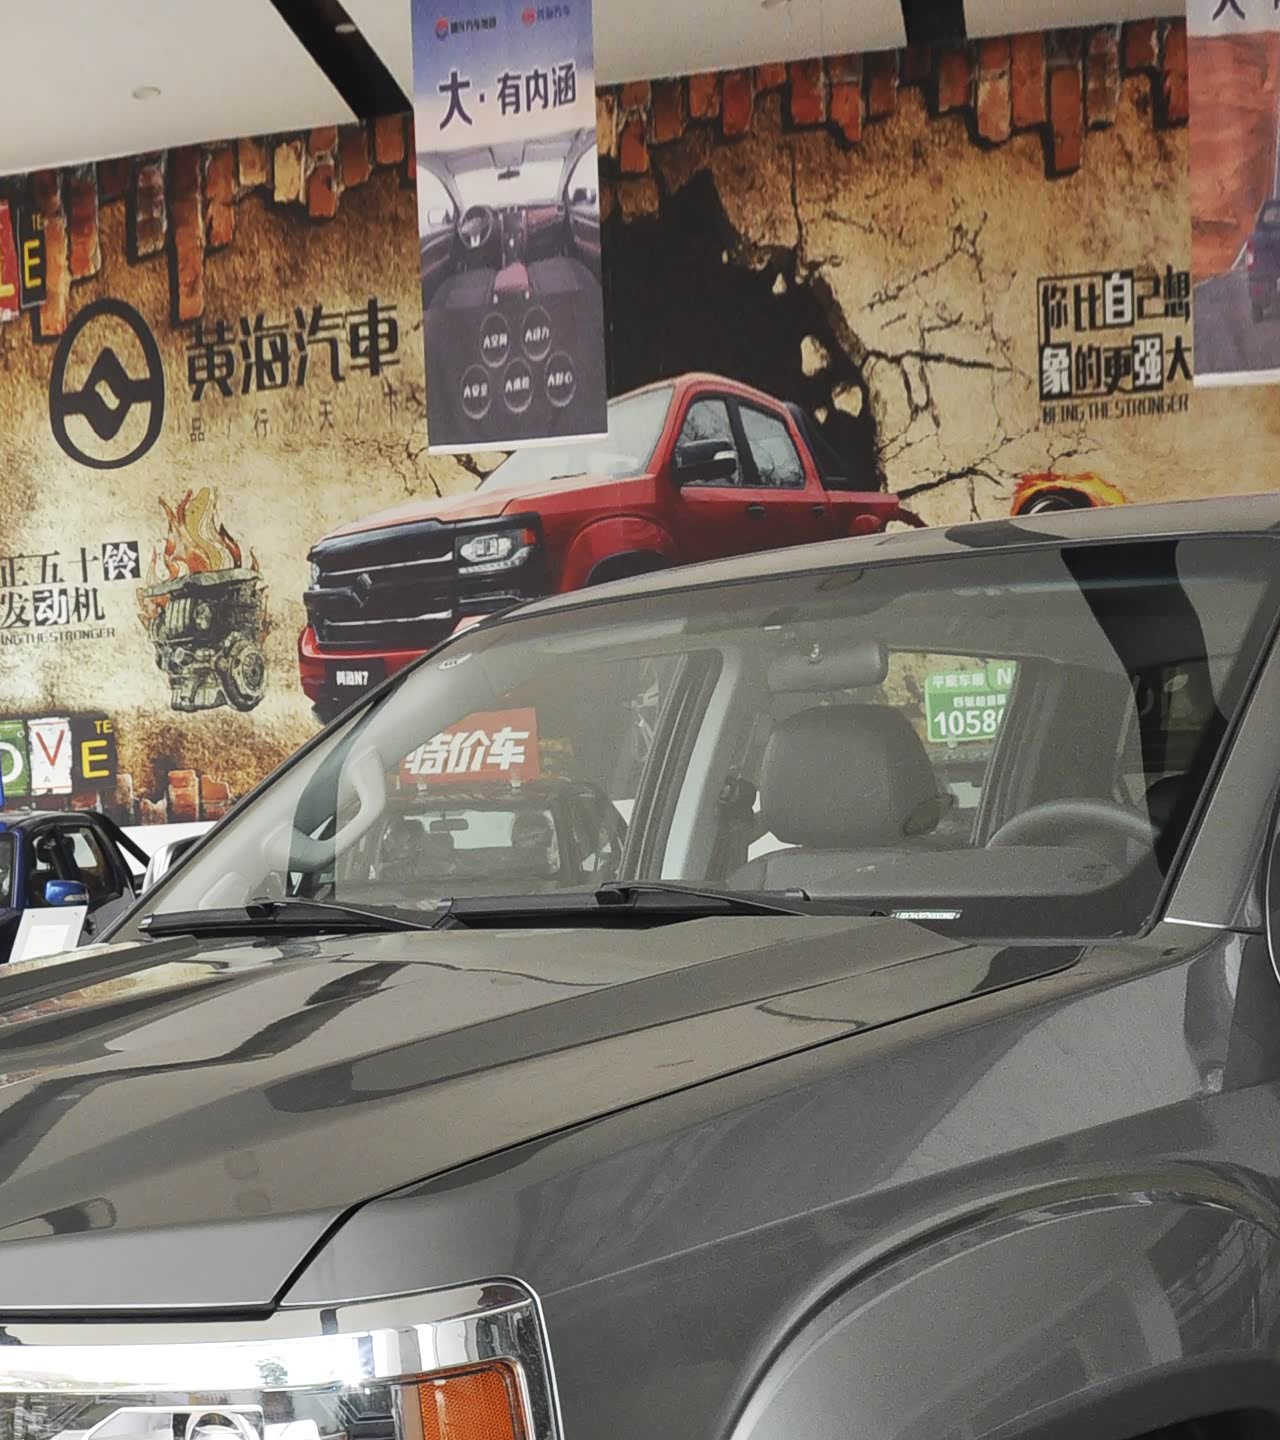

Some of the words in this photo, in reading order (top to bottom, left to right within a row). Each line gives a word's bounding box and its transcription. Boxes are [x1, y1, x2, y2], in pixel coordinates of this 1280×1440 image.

[439, 62, 577, 130] 大·有内涵
[185, 296, 401, 402] 黄海汽車
[1040, 333, 1192, 398] 象的更强大
[0, 586, 106, 629] 发动机
[404, 726, 530, 775] 特价车
